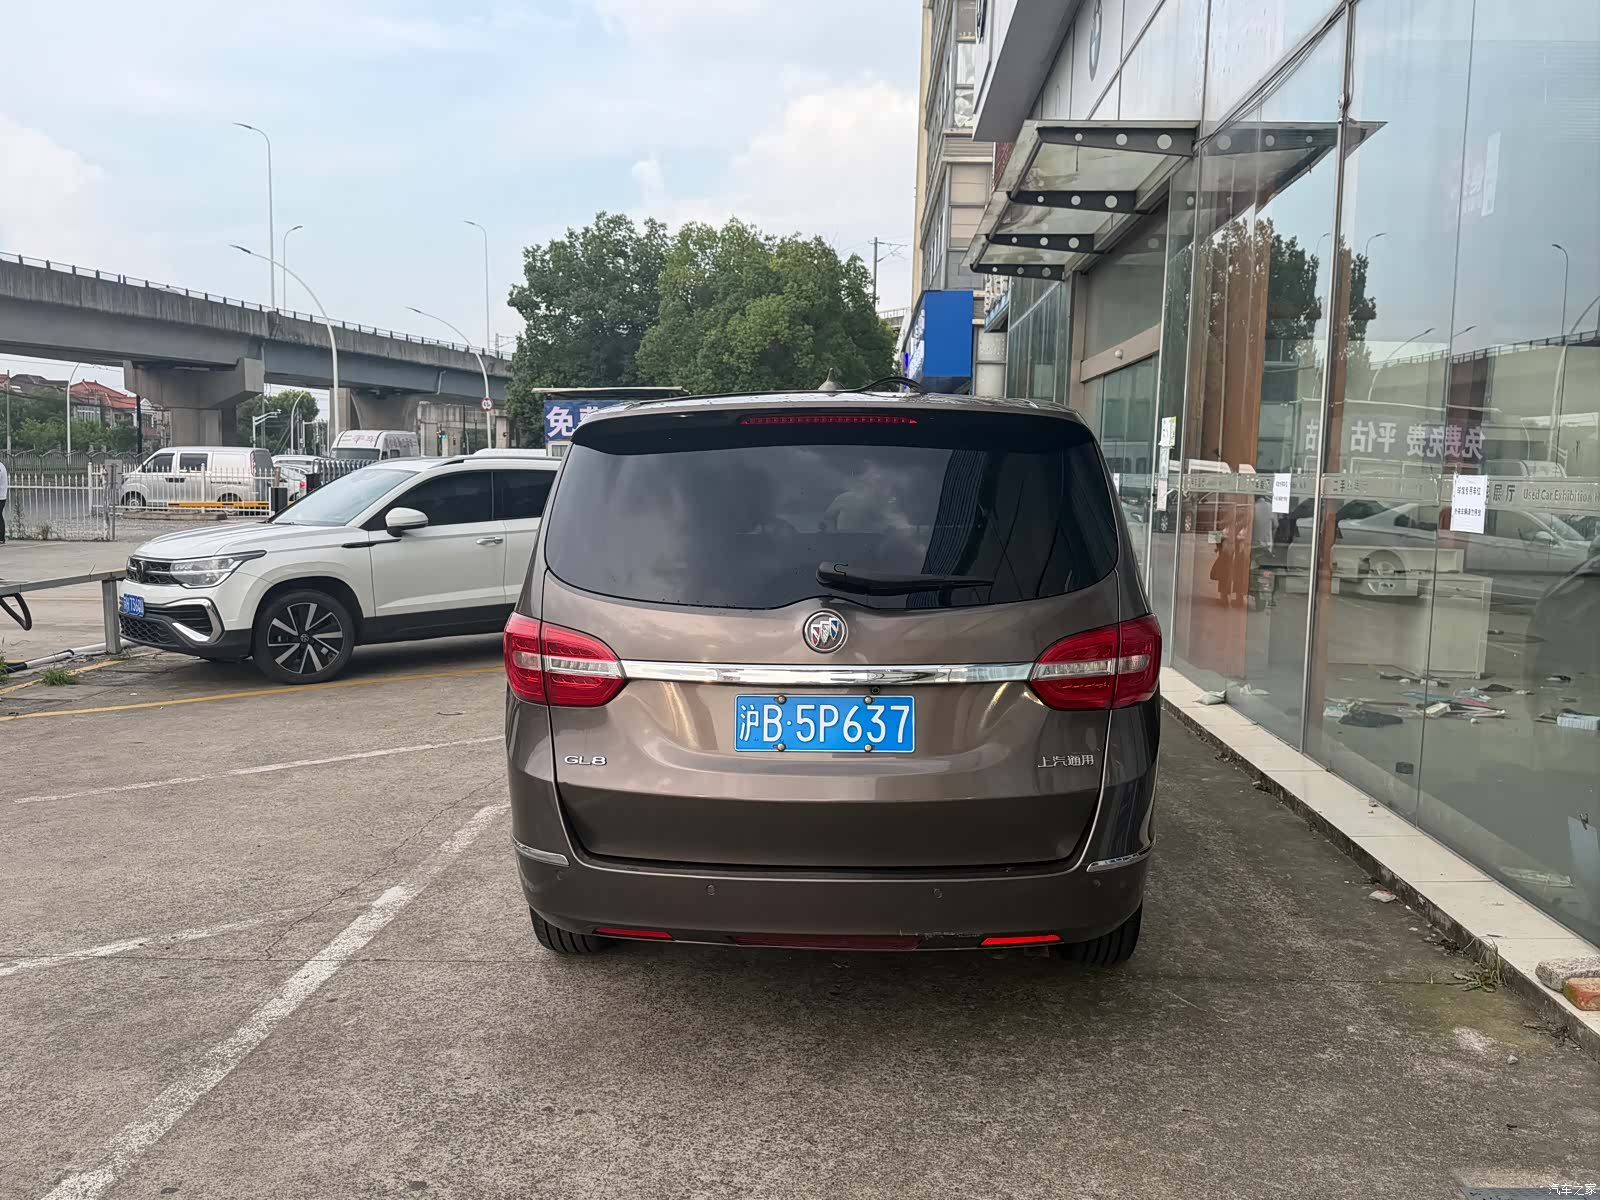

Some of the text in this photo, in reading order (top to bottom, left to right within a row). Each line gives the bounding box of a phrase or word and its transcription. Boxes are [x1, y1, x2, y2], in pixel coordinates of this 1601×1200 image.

[1523, 489, 1540, 501] Used
[1541, 489, 1553, 501] Car
[739, 703, 910, 744] 沪B·5P637
[564, 755, 607, 766] GL8
[1037, 754, 1094, 768] 上汽通用
